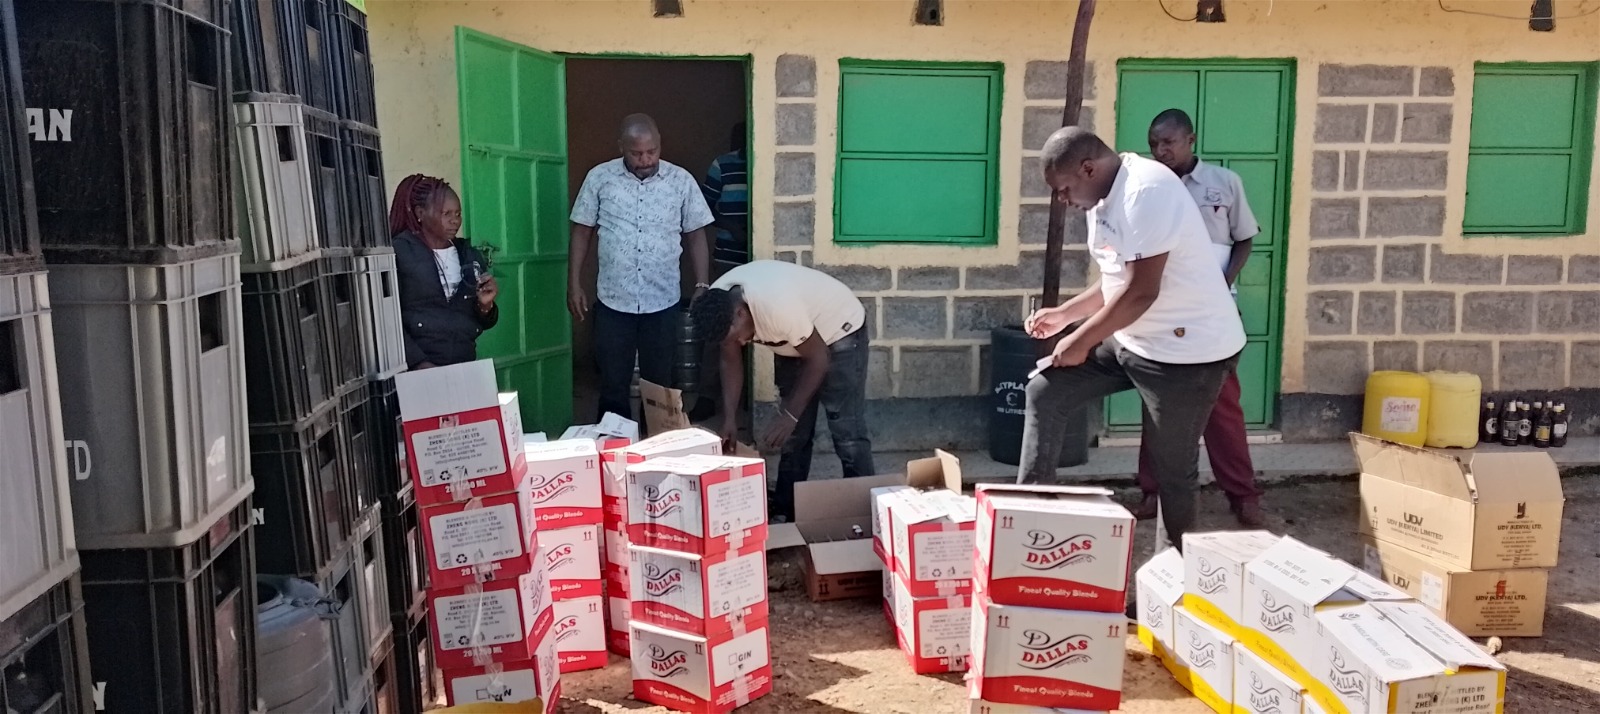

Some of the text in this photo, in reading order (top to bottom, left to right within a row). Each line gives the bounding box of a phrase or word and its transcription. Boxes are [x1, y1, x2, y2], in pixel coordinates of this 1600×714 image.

[645, 492, 681, 514] DALLAS
[1403, 512, 1424, 526] UDV
[1420, 528, 1444, 540] LIMITED
[1026, 539, 1092, 565] DALLAS
[646, 572, 682, 593] DALLAS
[1197, 573, 1226, 590] DALLAS
[1392, 573, 1411, 590] UDV
[1018, 585, 1099, 599] Finest Quality Blends
[1260, 610, 1294, 627] DALLAS
[738, 650, 752, 662] GIN
[1022, 639, 1088, 665] DALLAS
[651, 653, 687, 673] DALLAS
[1330, 668, 1364, 692] DALLAS
[1013, 684, 1094, 699] Finest Quality Blends
[1250, 692, 1280, 708] DALLAS
[1461, 697, 1471, 705] (K)
[1473, 694, 1485, 702] LTD
